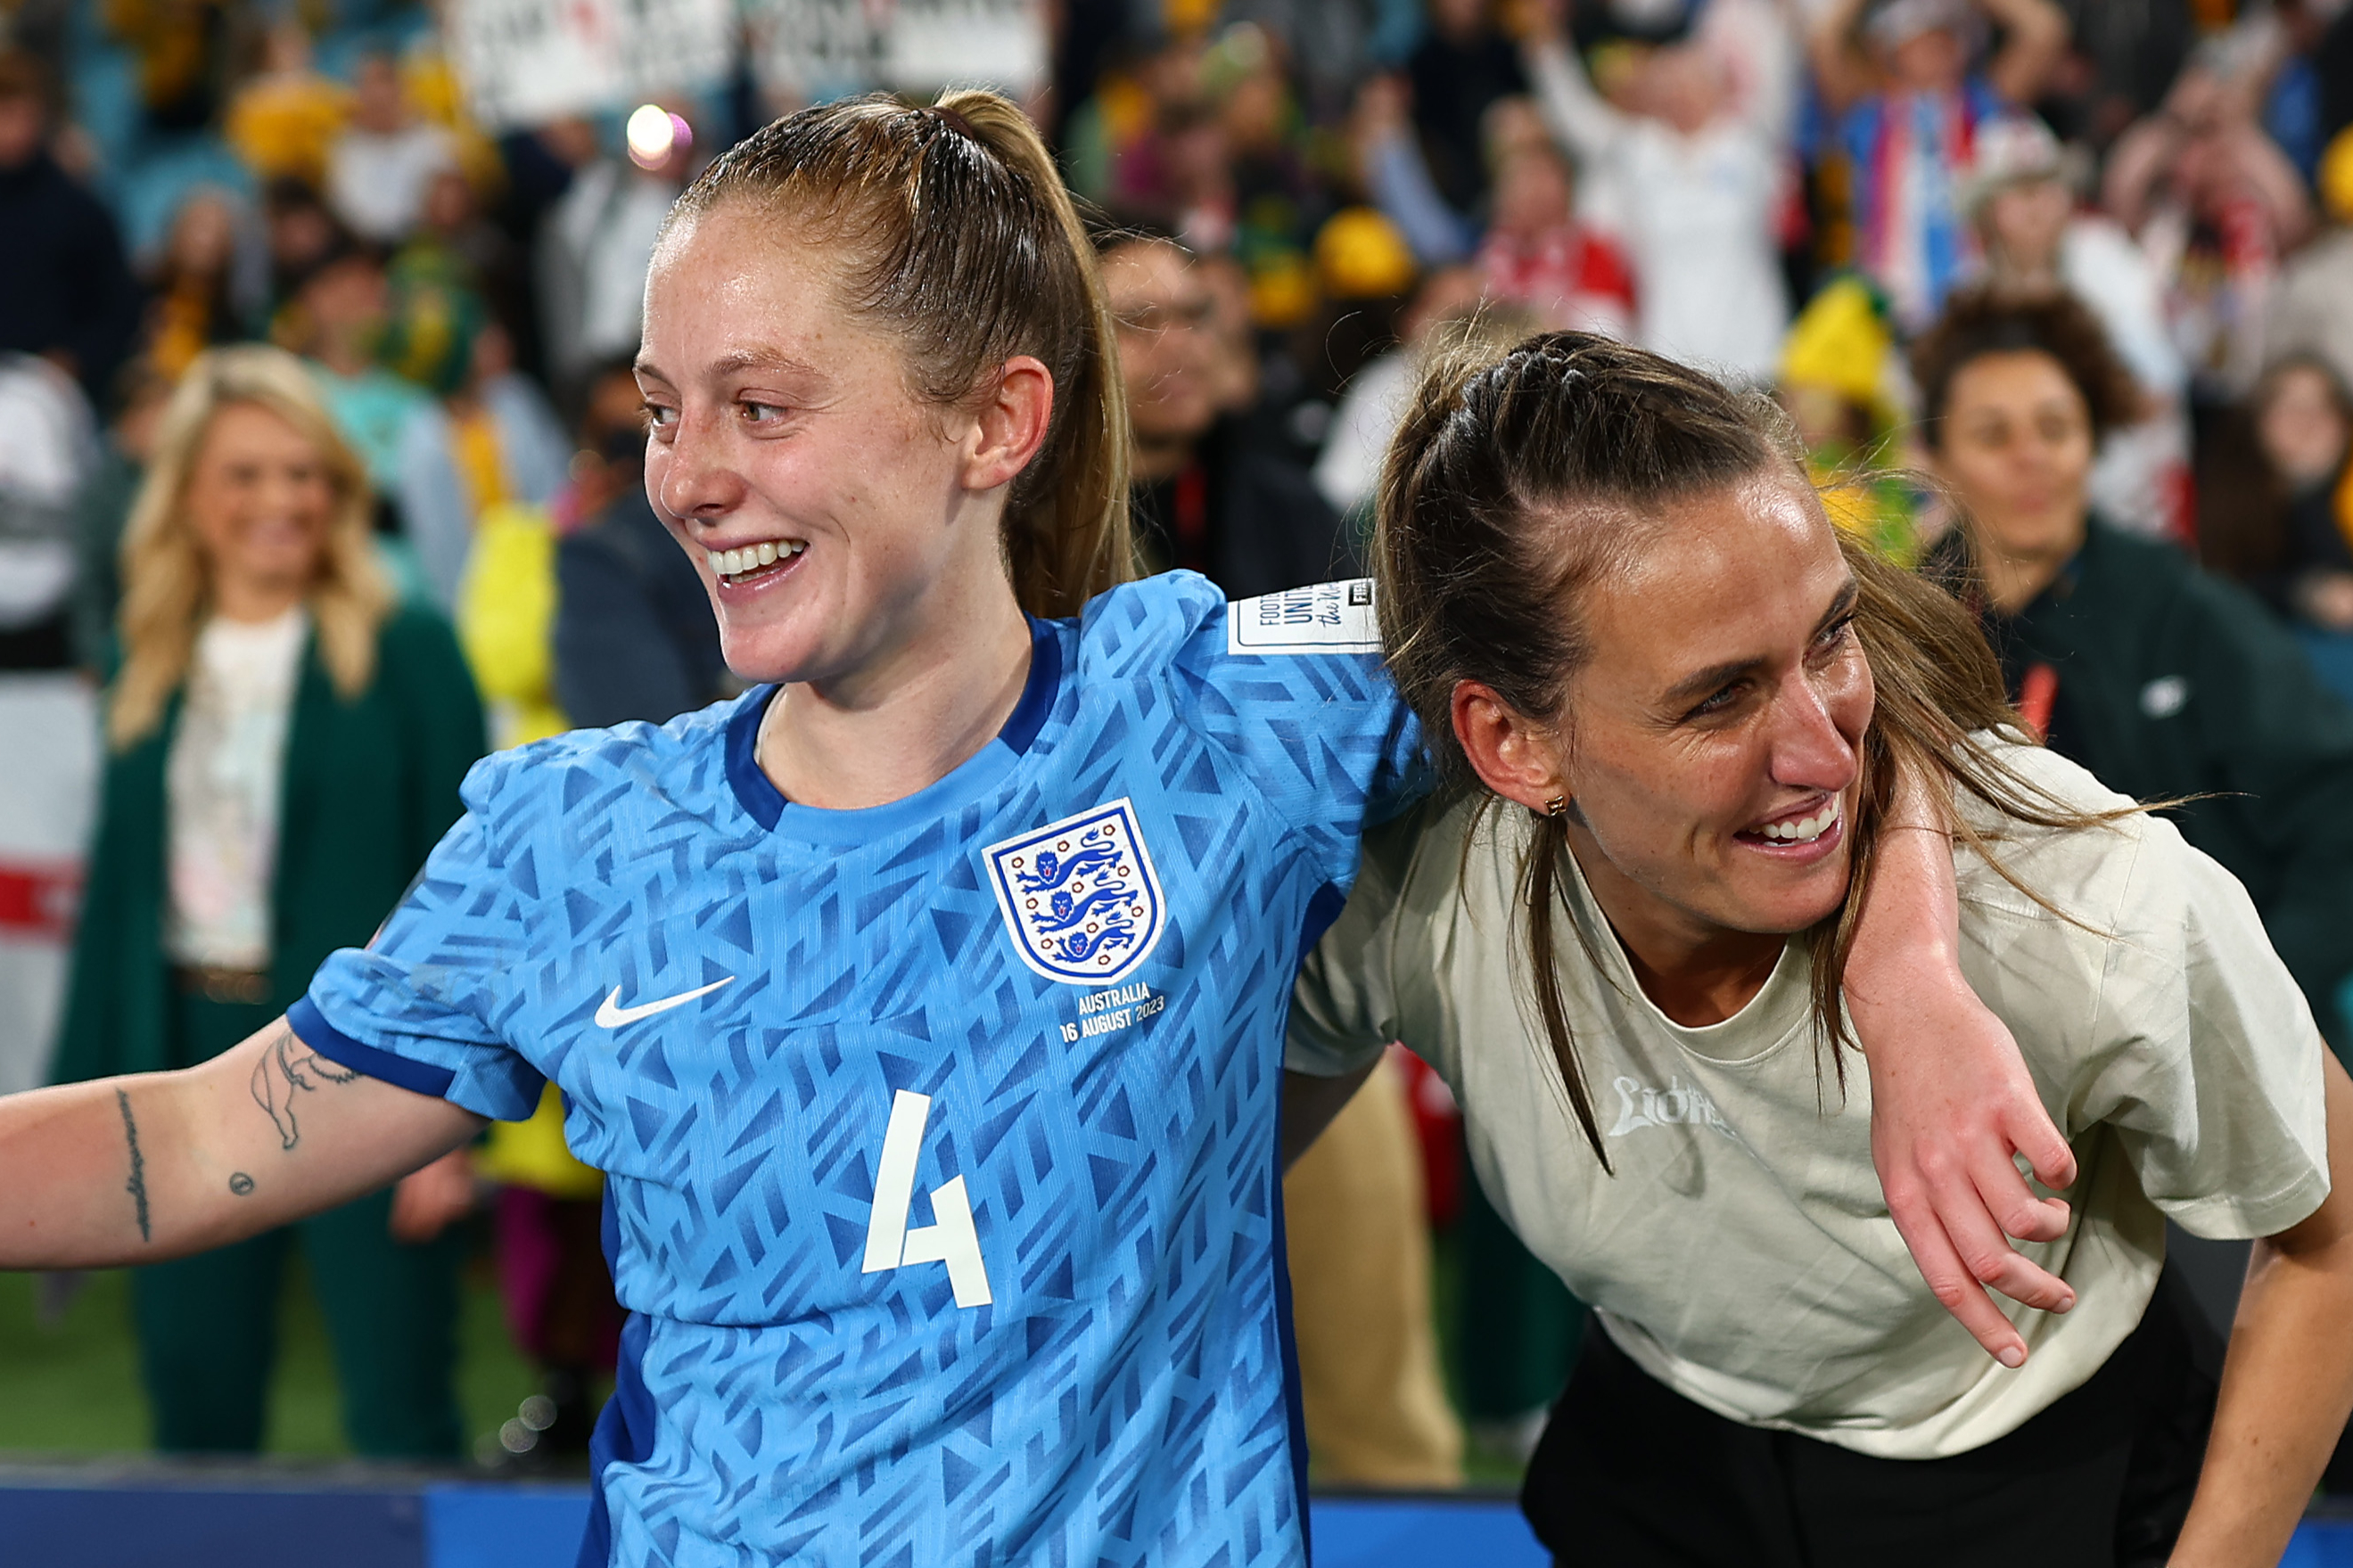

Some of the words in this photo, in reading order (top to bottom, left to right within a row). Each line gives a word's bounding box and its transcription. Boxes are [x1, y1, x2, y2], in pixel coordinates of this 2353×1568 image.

[1059, 1022, 1079, 1043] 16
[1082, 1008, 1131, 1038] AUGUST
[1135, 995, 1164, 1022] 2023
[1079, 981, 1150, 1015] AUSTRALIA
[861, 1088, 993, 1309] 4
